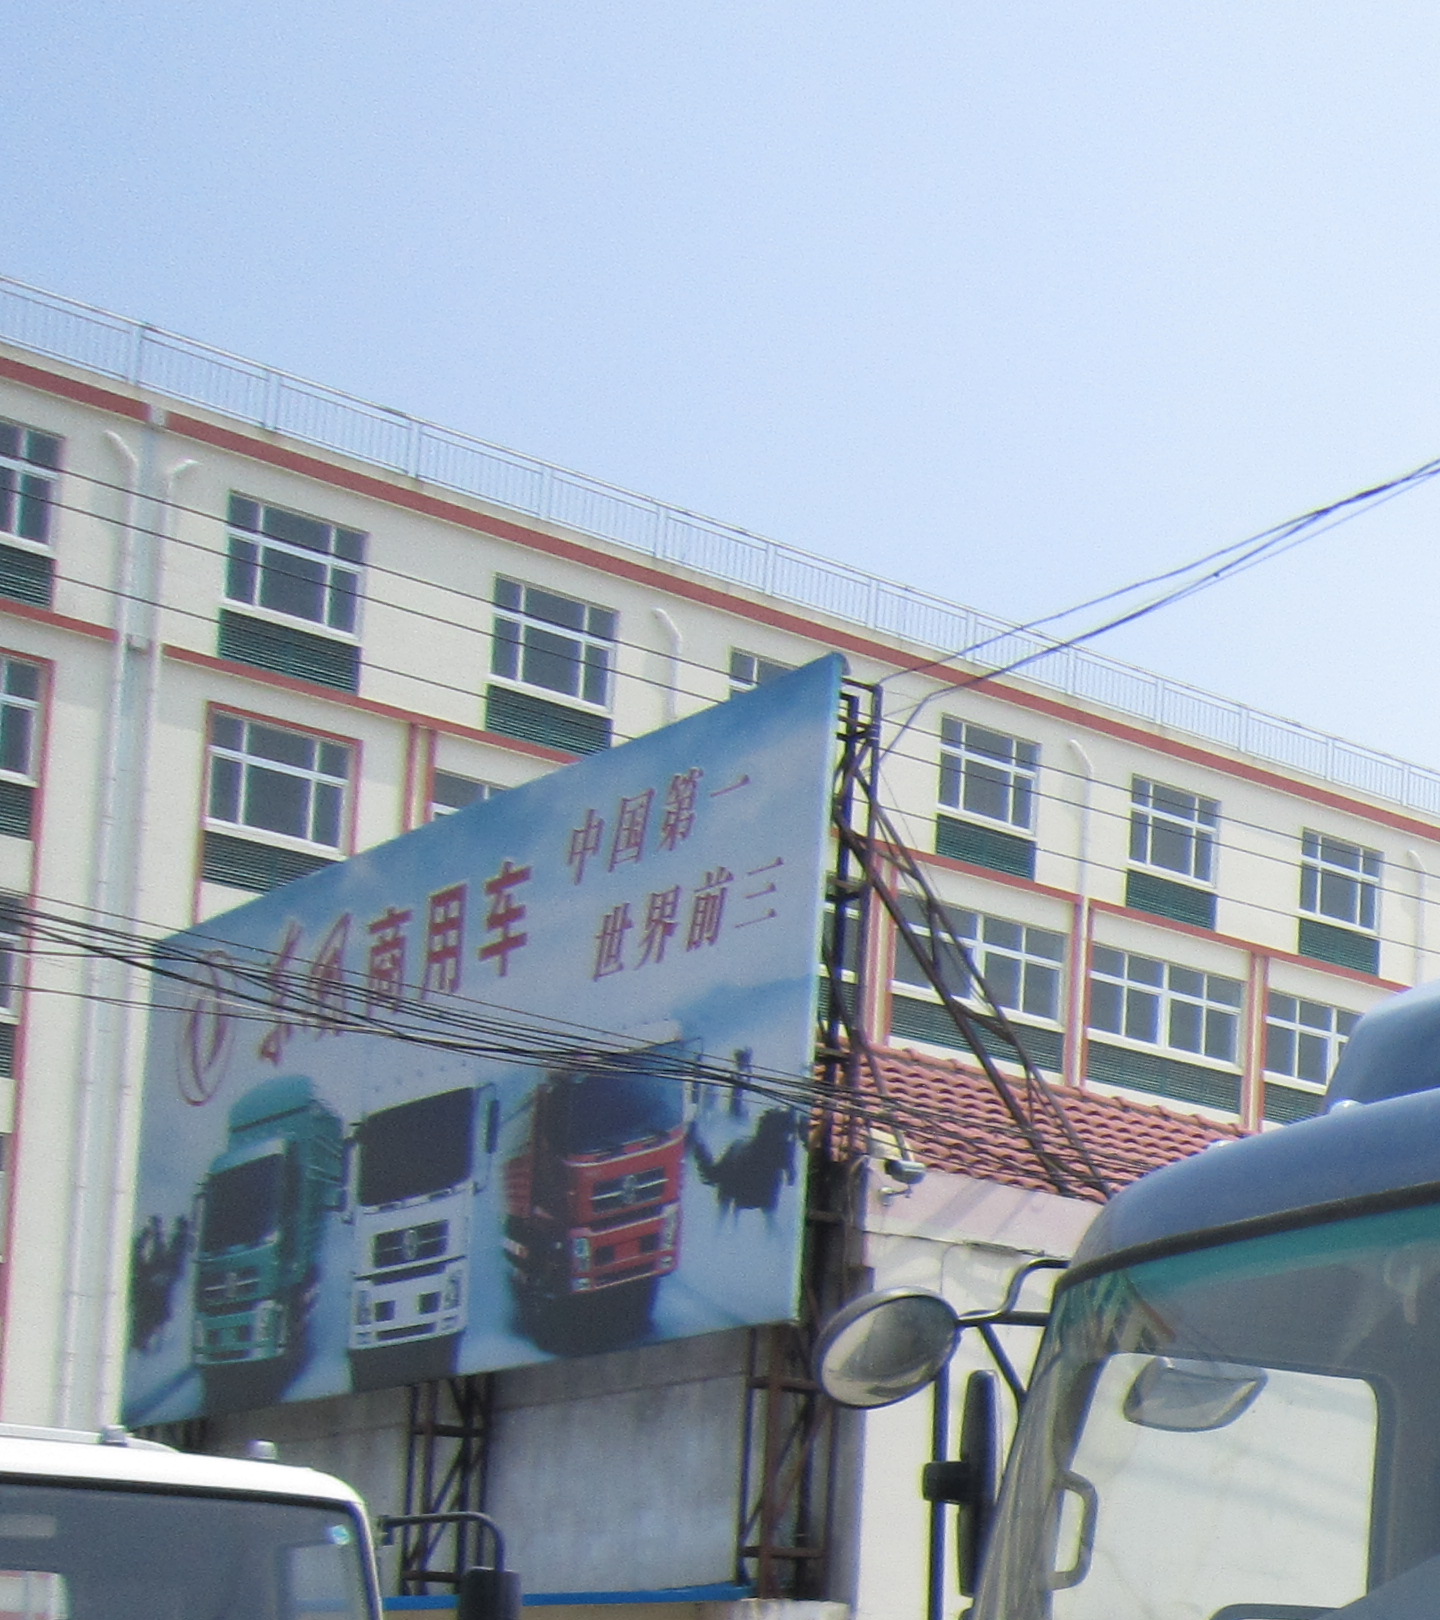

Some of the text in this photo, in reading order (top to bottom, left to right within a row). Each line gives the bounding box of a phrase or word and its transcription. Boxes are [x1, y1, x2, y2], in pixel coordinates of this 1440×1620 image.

[567, 767, 750, 886] 中国第一
[592, 857, 785, 982] 世界前三
